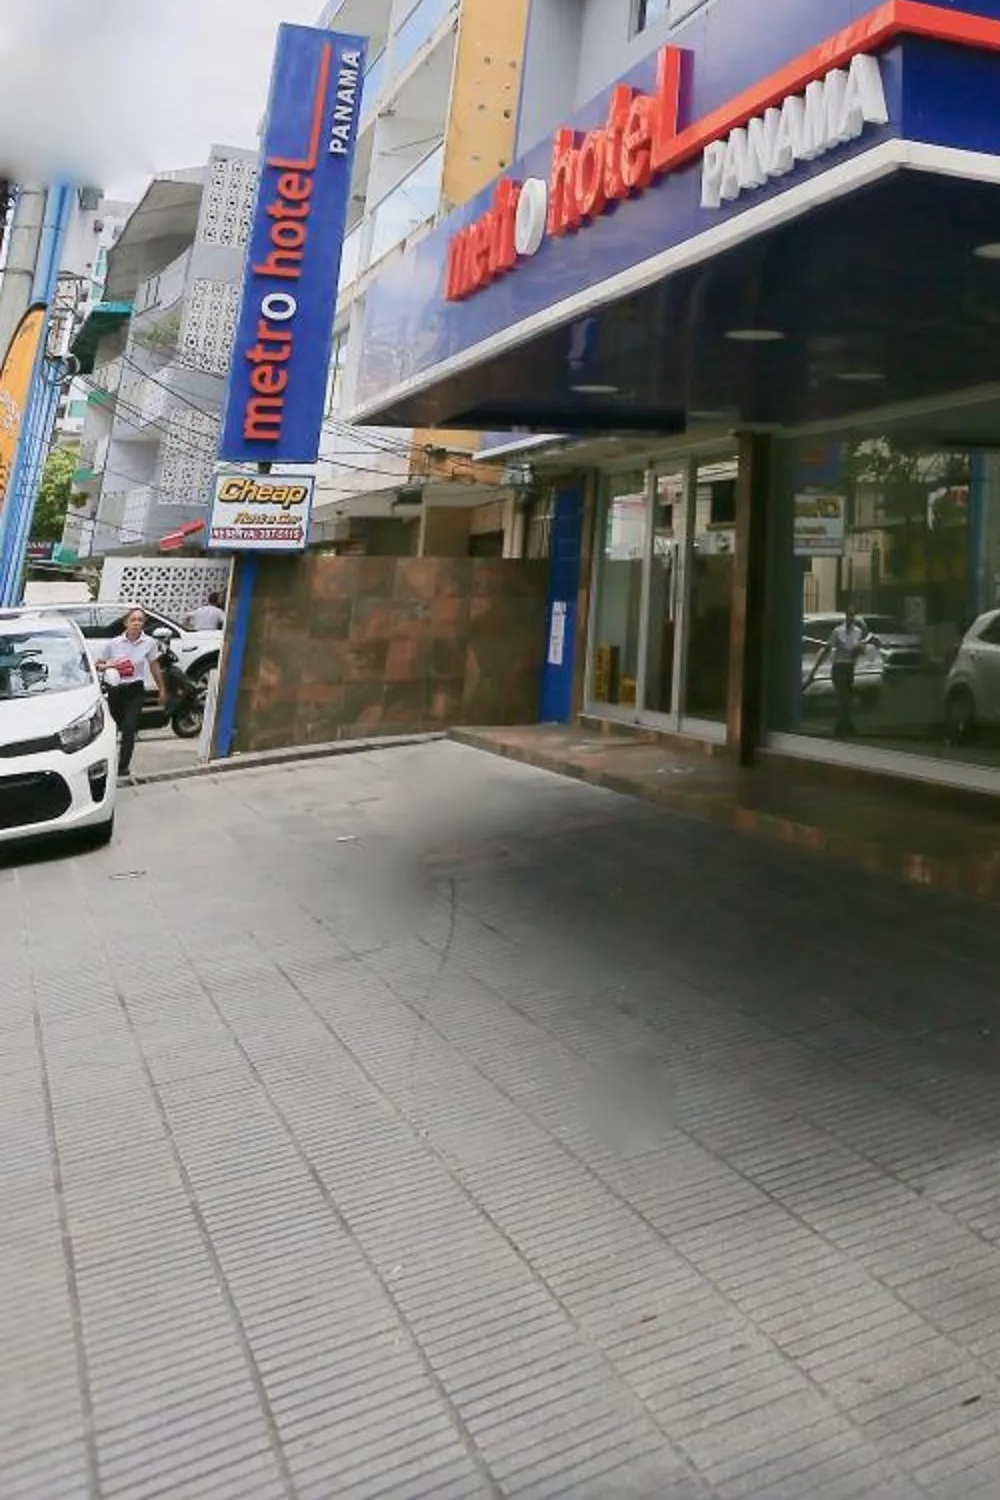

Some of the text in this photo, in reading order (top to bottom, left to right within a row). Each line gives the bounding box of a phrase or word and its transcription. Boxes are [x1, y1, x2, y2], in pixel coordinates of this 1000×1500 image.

[330, 50, 361, 154] PANAMA
[444, 45, 682, 301] metro hotel
[700, 53, 889, 208] PANAMA
[243, 293, 297, 442] metro
[218, 478, 308, 510] Cheap
